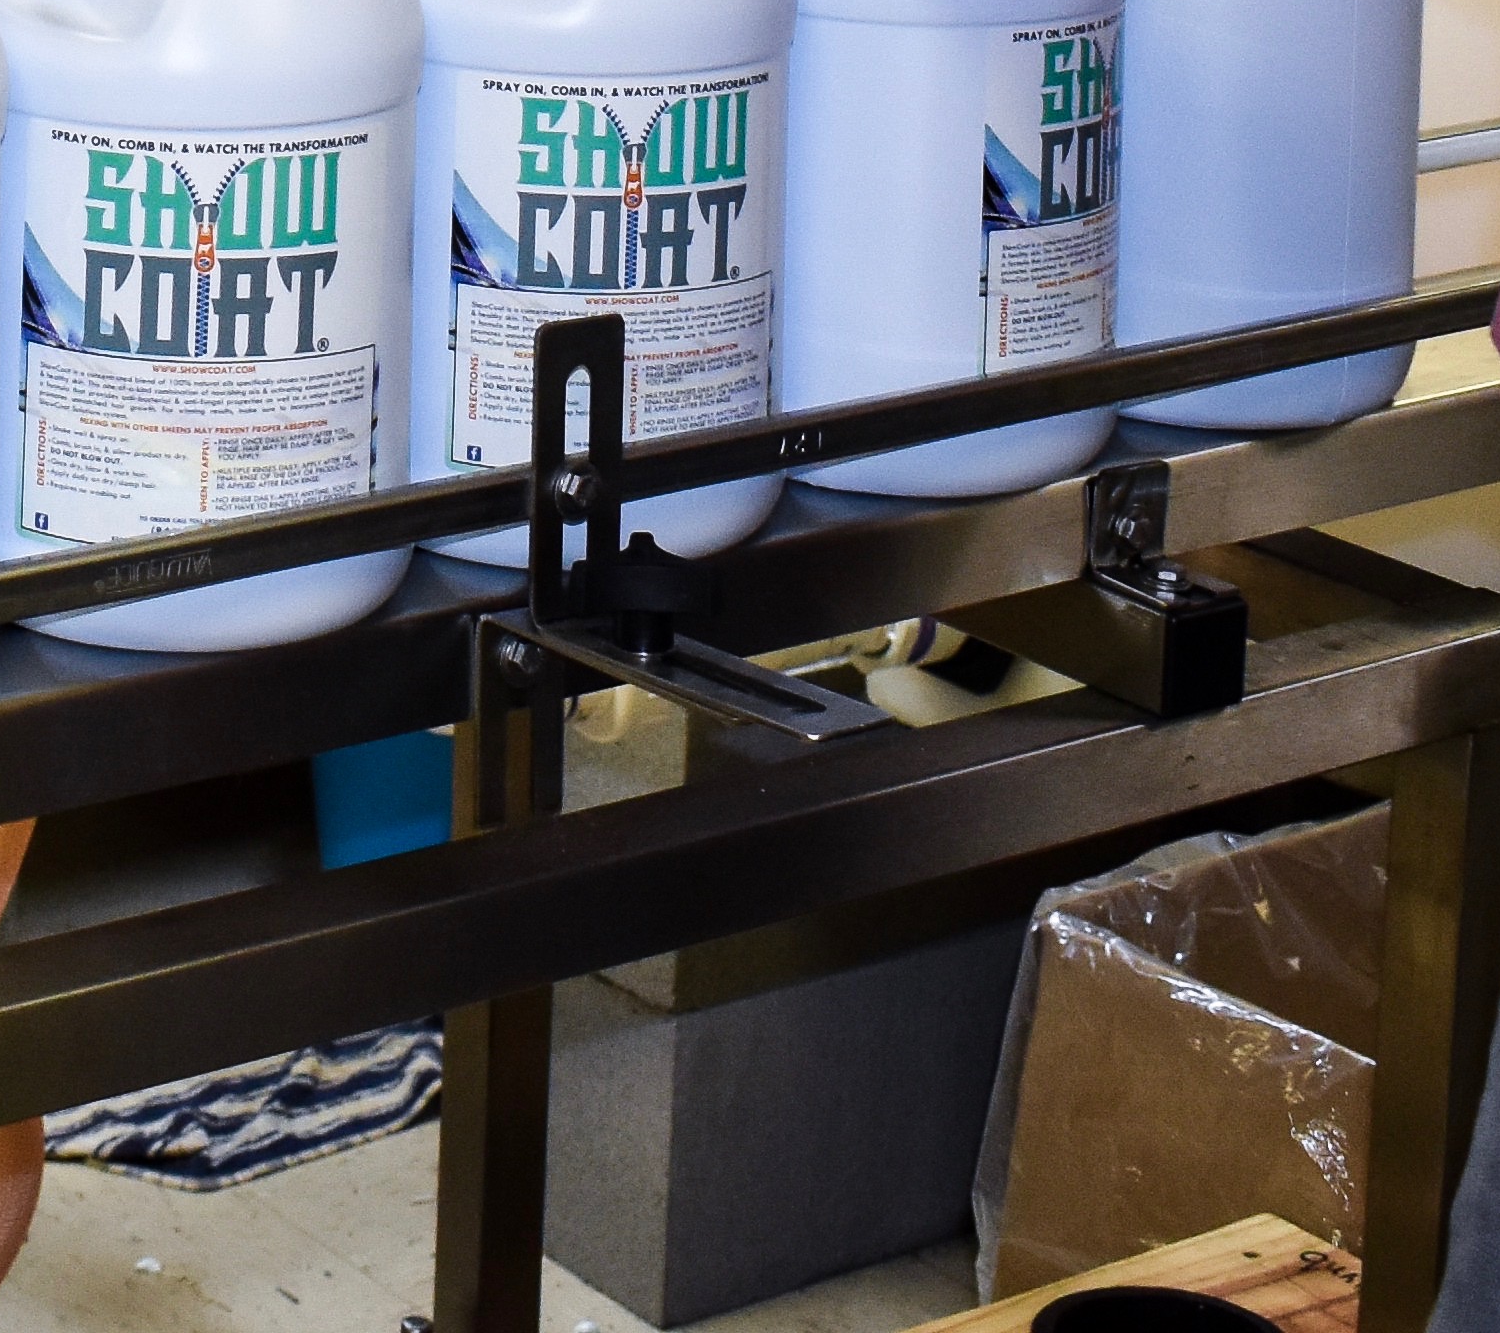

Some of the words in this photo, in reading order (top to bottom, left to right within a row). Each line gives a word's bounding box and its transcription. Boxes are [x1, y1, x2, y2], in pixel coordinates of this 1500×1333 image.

[1012, 30, 1043, 42] SPRAY
[483, 79, 520, 93] SPRAY
[524, 83, 546, 95] ON,
[551, 85, 587, 97] COMB
[591, 86, 607, 98] IN,
[611, 86, 619, 97] &
[623, 85, 664, 97] WATCH
[667, 84, 687, 95] THE
[51, 129, 87, 144] SPRAY
[91, 135, 113, 149] ON,
[118, 139, 155, 152] COMB
[159, 141, 176, 154] IN,
[181, 143, 189, 153] &
[194, 143, 239, 154] WATCH
[243, 143, 265, 154] THE
[269, 133, 369, 153] TRANSFORMATION!
[518, 90, 748, 189] SHOW
[83, 149, 340, 250] SHOW
[516, 183, 747, 289] COAT
[82, 247, 338, 359] COAT
[584, 295, 679, 305] WWW.SHOWCOAT.COM
[152, 365, 256, 375] WWW.SHOWCOAT.COM
[468, 353, 479, 420] DIRECTIONS:
[133, 424, 159, 433] OTHER
[215, 426, 249, 434] PREVENT
[36, 416, 47, 487] DIRECTIONS:
[63, 449, 78, 458] NOT
[200, 470, 209, 481] TO
